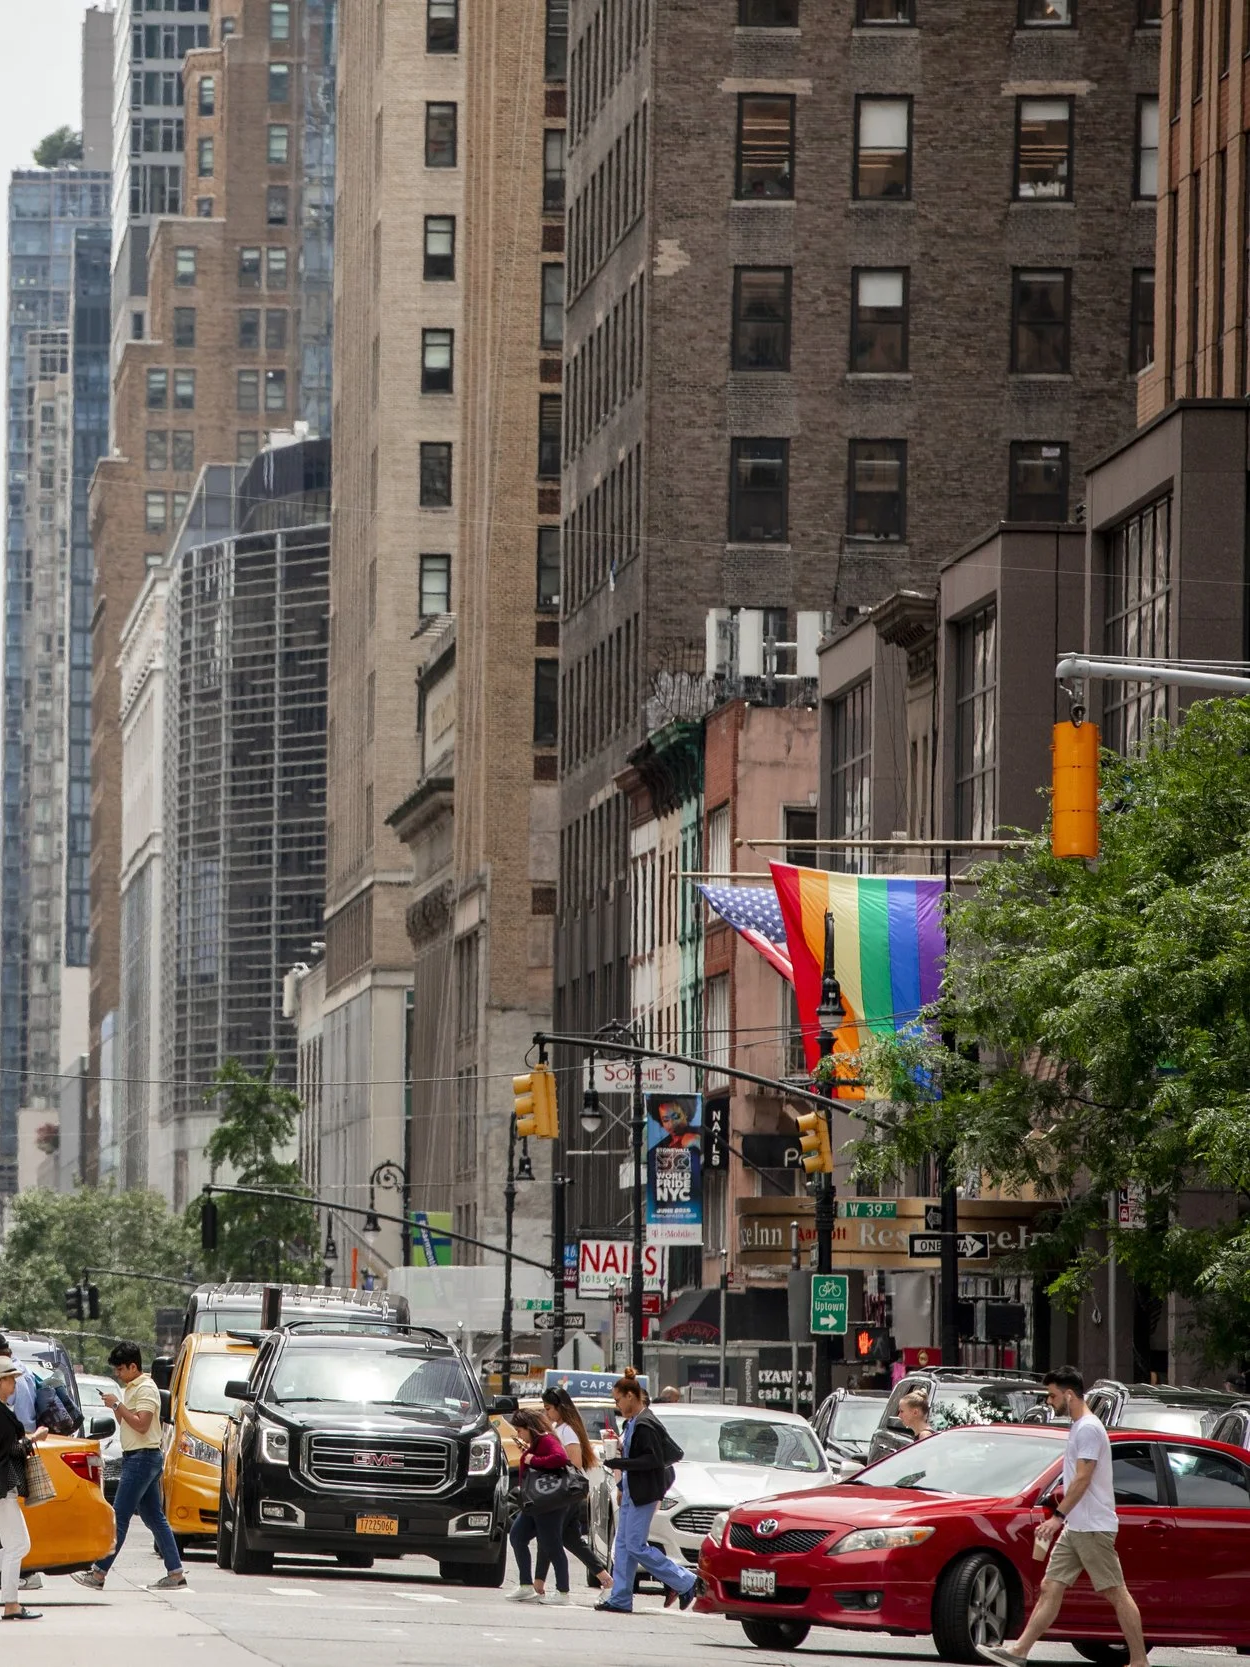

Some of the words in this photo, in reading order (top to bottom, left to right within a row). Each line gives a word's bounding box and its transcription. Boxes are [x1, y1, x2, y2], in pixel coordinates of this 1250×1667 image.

[711, 1110, 721, 1167] NAILS
[657, 1172, 691, 1180] WORLD
[657, 1180, 691, 1188] PRIDE
[657, 1188, 691, 1202] NYC
[850, 1203, 860, 1217] W
[866, 1203, 883, 1217] 39
[581, 1243, 658, 1276] NAIS
[581, 1275, 601, 1284] 1015
[532, 1301, 542, 1309] 38
[815, 1301, 845, 1312] Uptown
[353, 1452, 405, 1468] GMC
